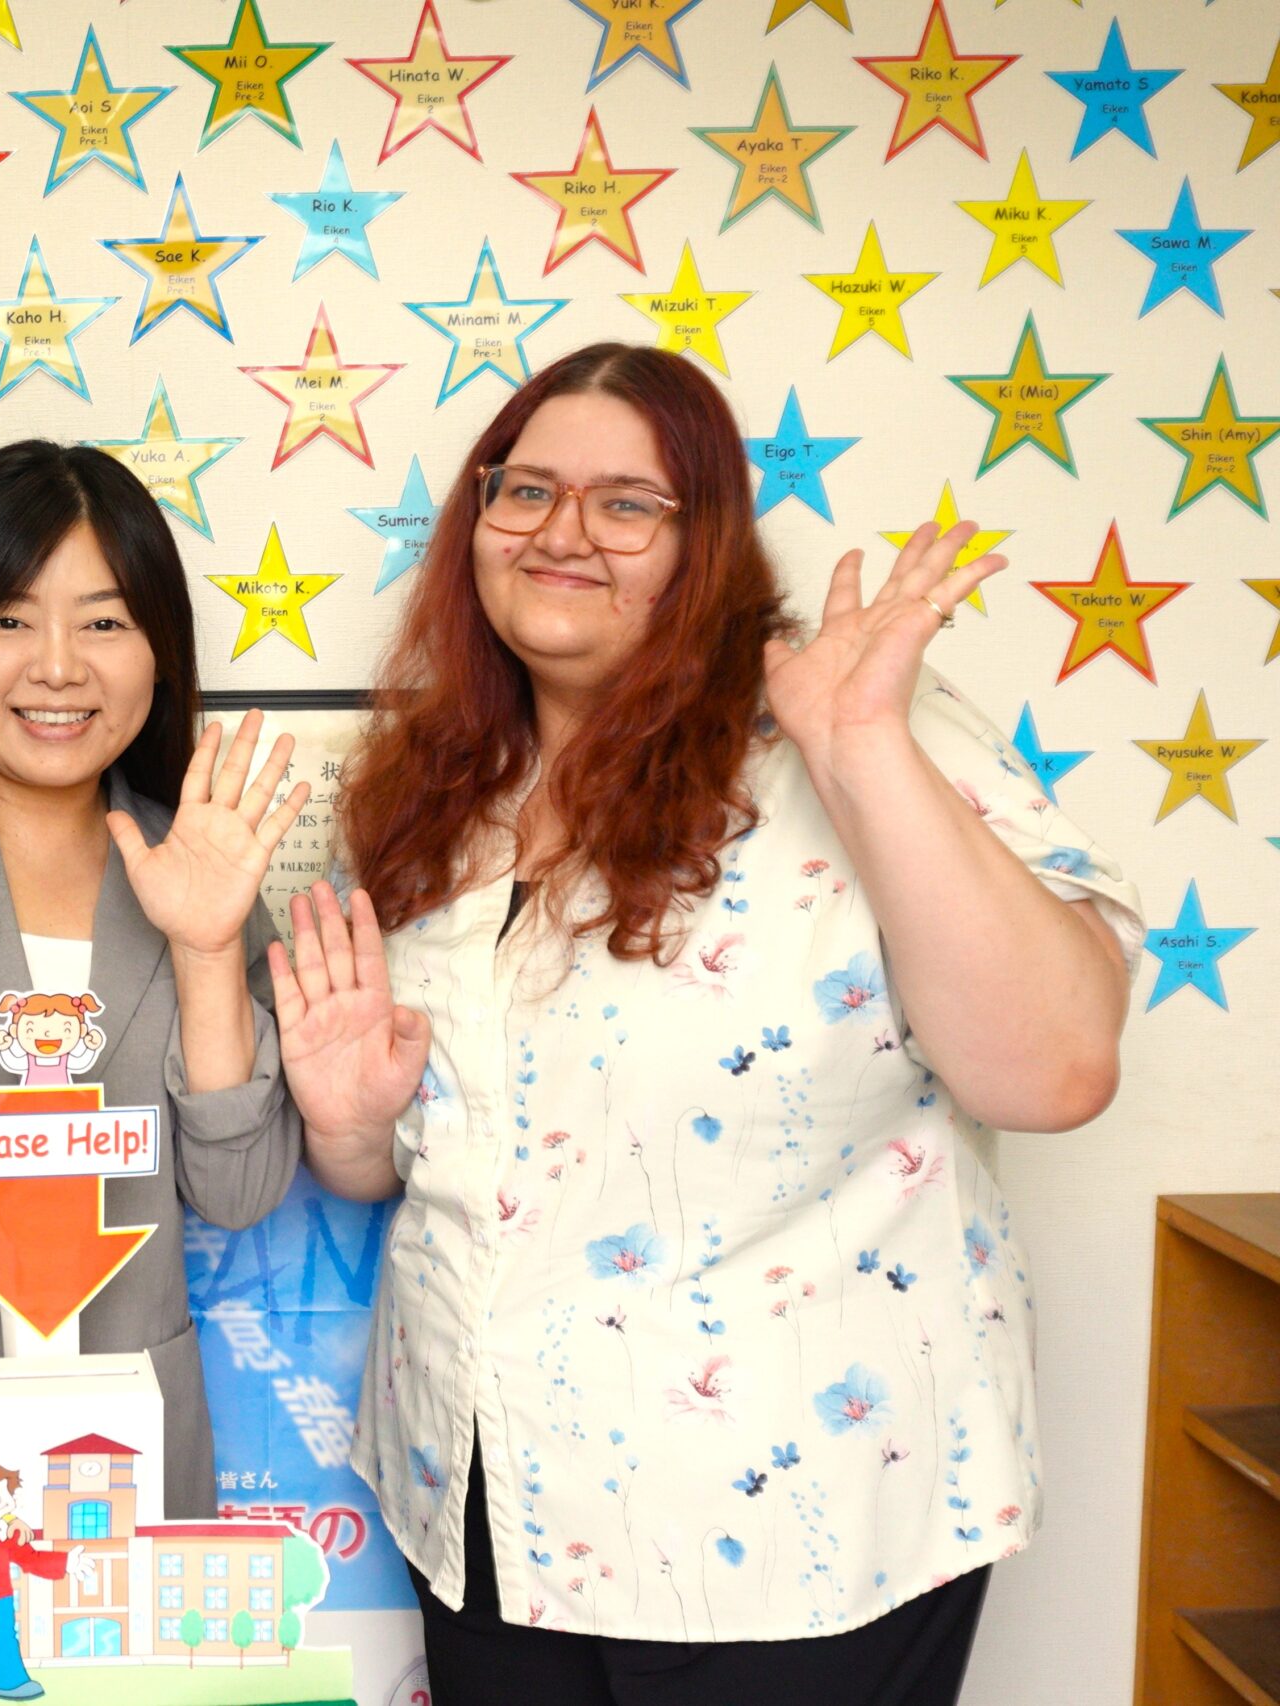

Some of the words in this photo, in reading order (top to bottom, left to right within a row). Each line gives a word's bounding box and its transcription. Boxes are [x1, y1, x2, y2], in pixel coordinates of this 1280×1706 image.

[626, 21, 653, 31] Eiken
[624, 32, 652, 41] Pre-1
[224, 56, 247, 69] Mii
[389, 69, 440, 82] Hinata
[910, 67, 942, 80] Riko
[236, 81, 263, 91] Eiken
[1074, 78, 1131, 91] Yamato
[235, 91, 264, 101] Pre-2
[417, 94, 444, 104] Eiken
[925, 93, 952, 102] Eiken
[1241, 90, 1280, 103] Koha
[69, 101, 93, 114] Aoi
[1102, 104, 1129, 114] Eiken
[81, 126, 108, 135] Eiken
[80, 136, 108, 145] Pre-1
[737, 138, 783, 155] Ayaka
[759, 164, 787, 173] Eiken
[758, 174, 788, 185] Pre-2
[564, 181, 596, 194] Riko
[313, 199, 335, 212] Rio
[580, 207, 607, 216] Eiken
[994, 207, 1029, 220] Miku
[324, 225, 350, 235] Eiken
[1011, 233, 1038, 243] Eiken
[1151, 236, 1190, 249] Sawa
[155, 250, 183, 263] Sae
[1171, 264, 1198, 273] Eiken
[831, 280, 881, 293] Hazuki
[650, 298, 698, 312] Mizuki
[859, 306, 885, 316] Eiken
[7, 310, 42, 324] Kaho
[447, 313, 499, 326] Minami
[675, 325, 701, 335] Eiken
[25, 336, 51, 345] Eiken
[473, 348, 501, 358] Pre-1
[295, 376, 321, 389] Mei
[998, 386, 1012, 399] Ki
[1020, 384, 1060, 401] (Mia)
[1014, 411, 1042, 421] Eiken
[1014, 422, 1043, 431] Pre-2
[1181, 428, 1212, 441] Shin
[1219, 428, 1263, 446] (Amy)
[131, 450, 166, 464] Yuka
[765, 444, 796, 461] Eigo
[1208, 454, 1235, 463] Eiken
[1206, 464, 1236, 474] Pre-2
[780, 472, 806, 481] Eiken
[377, 514, 429, 527] Sumire
[237, 581, 287, 594] Mikoto
[1070, 593, 1122, 606] Takuto
[262, 607, 288, 616] Eiken
[1098, 618, 1125, 628] Eiken
[1157, 745, 1213, 761] Ryusuke
[1186, 772, 1212, 781] Eiken
[296, 815, 318, 827] JES
[1159, 935, 1199, 948] Asahi
[67, 1119, 148, 1165] Help!
[216, 1471, 278, 1489] 皆さん
